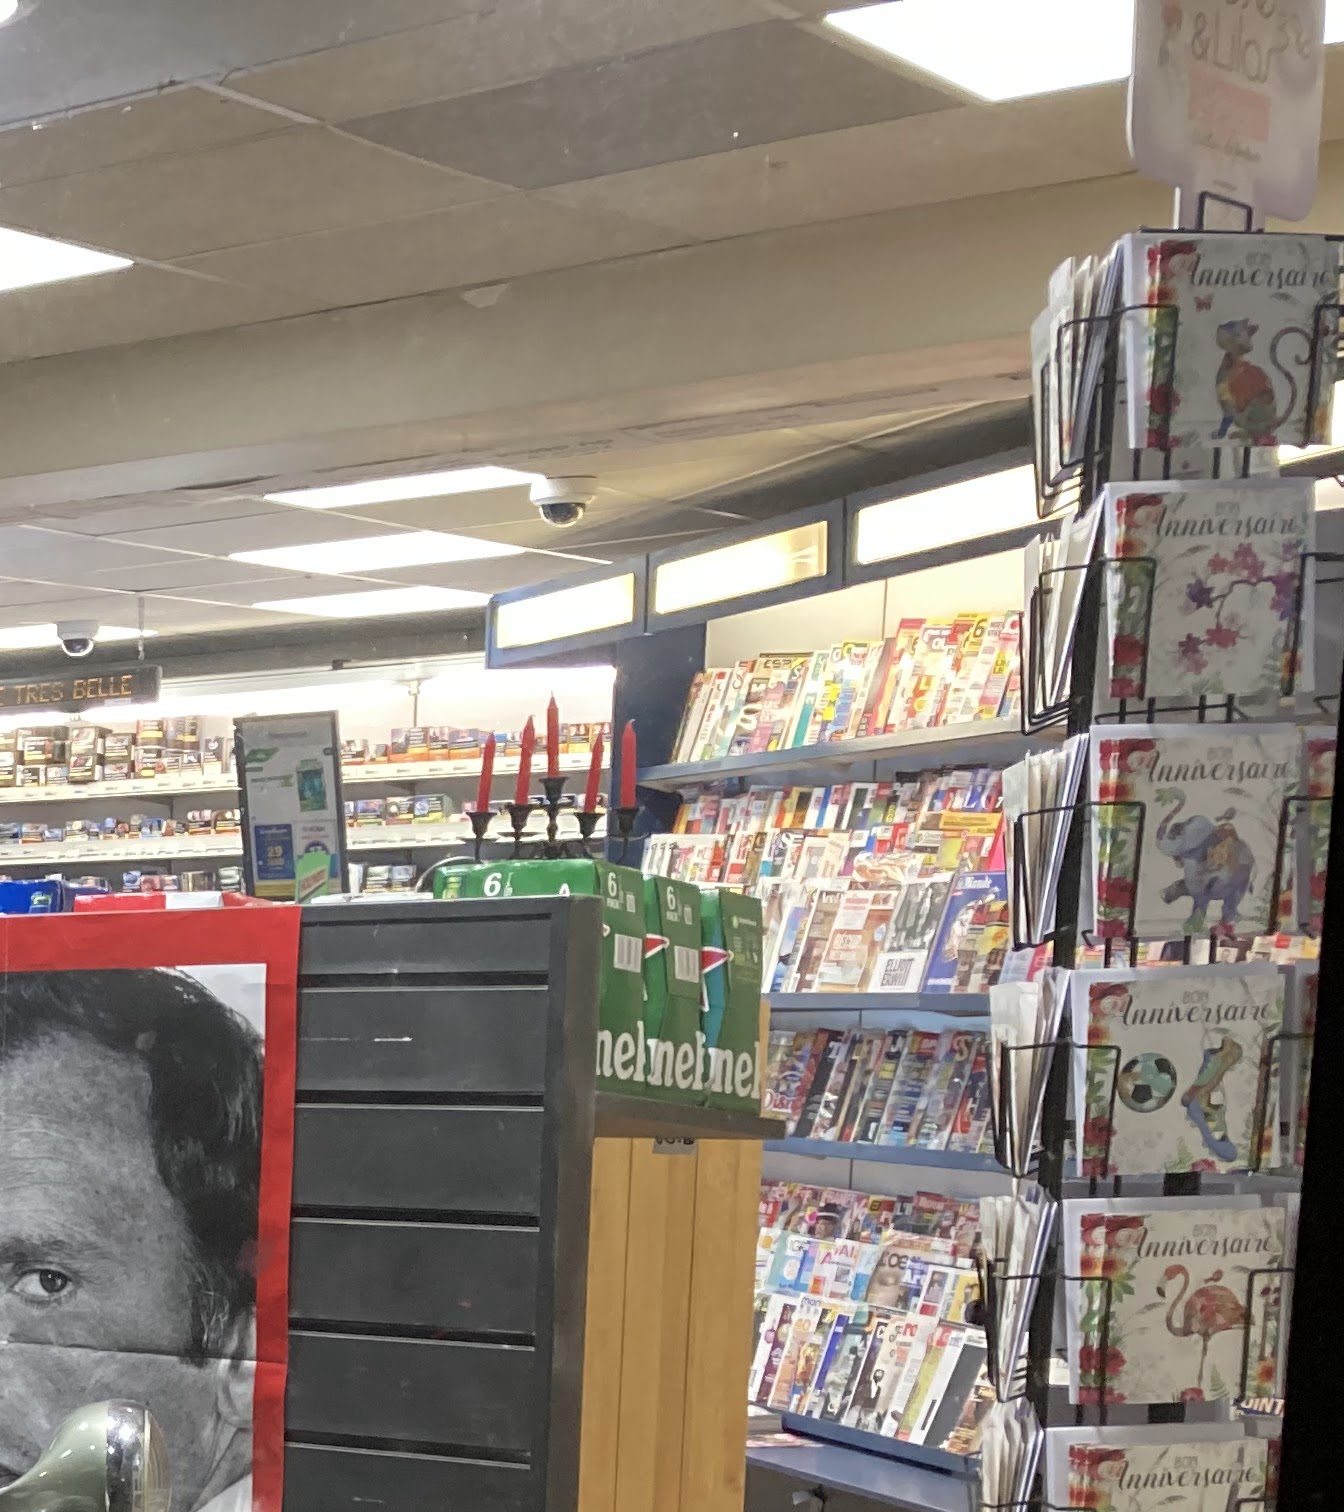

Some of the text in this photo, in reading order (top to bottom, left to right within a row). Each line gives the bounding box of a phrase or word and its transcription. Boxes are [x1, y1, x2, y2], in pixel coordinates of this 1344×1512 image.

[15, 682, 63, 705] TRES
[73, 675, 133, 699] BELLE
[484, 873, 501, 897] 6
[608, 872, 617, 896] 6
[666, 886, 676, 910] 6
